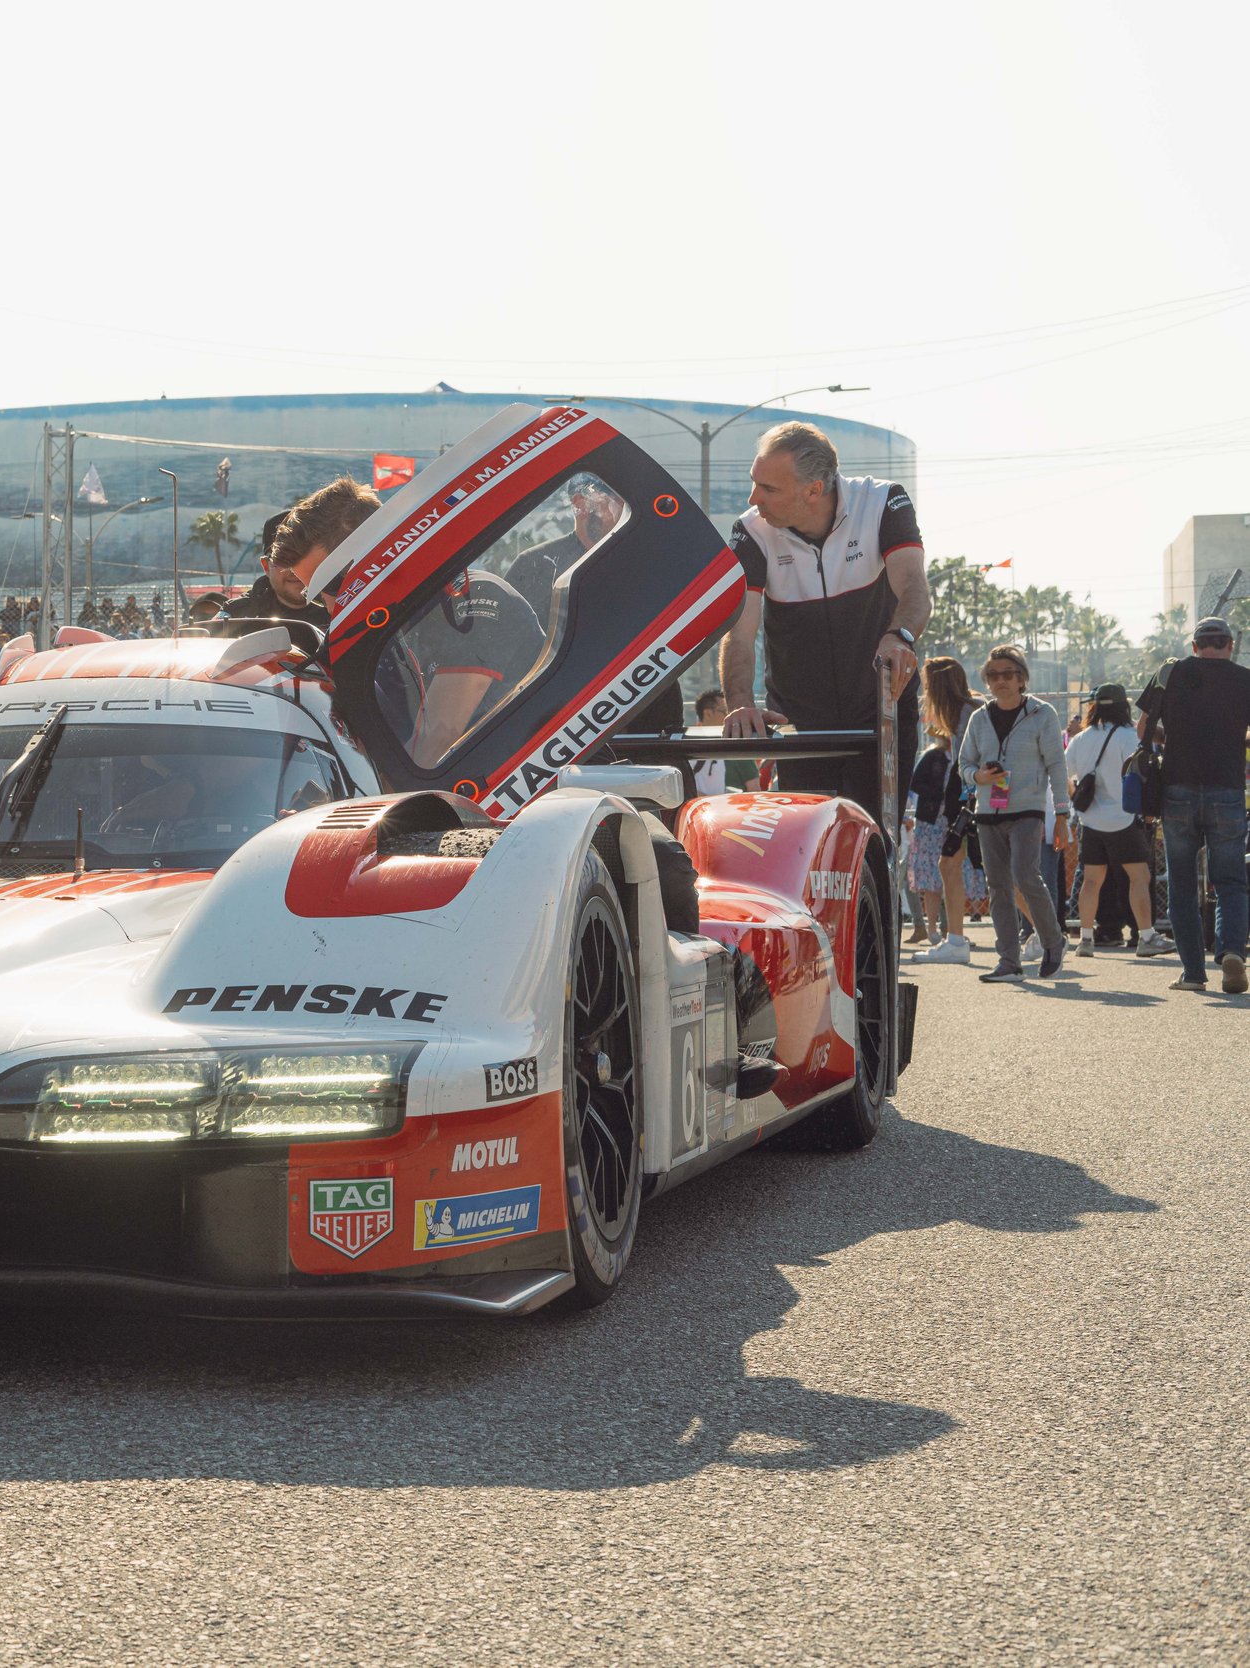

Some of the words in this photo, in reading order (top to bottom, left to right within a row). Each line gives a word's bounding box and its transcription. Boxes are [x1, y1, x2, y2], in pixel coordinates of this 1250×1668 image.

[475, 466, 502, 483] M.
[504, 408, 581, 466] JAMINET
[364, 562, 386, 578] N.
[382, 508, 441, 559] TANDY
[810, 870, 852, 901] PENSKE
[161, 984, 449, 1024] PENSKE
[672, 998, 702, 1019] WeatherTech
[490, 1061, 537, 1097] BOSS
[681, 1031, 695, 1143] 6
[451, 1136, 519, 1172] MOTUL
[317, 1184, 386, 1209] TAG
[316, 1213, 388, 1251] HEUER
[456, 1202, 530, 1230] MICHELIN
